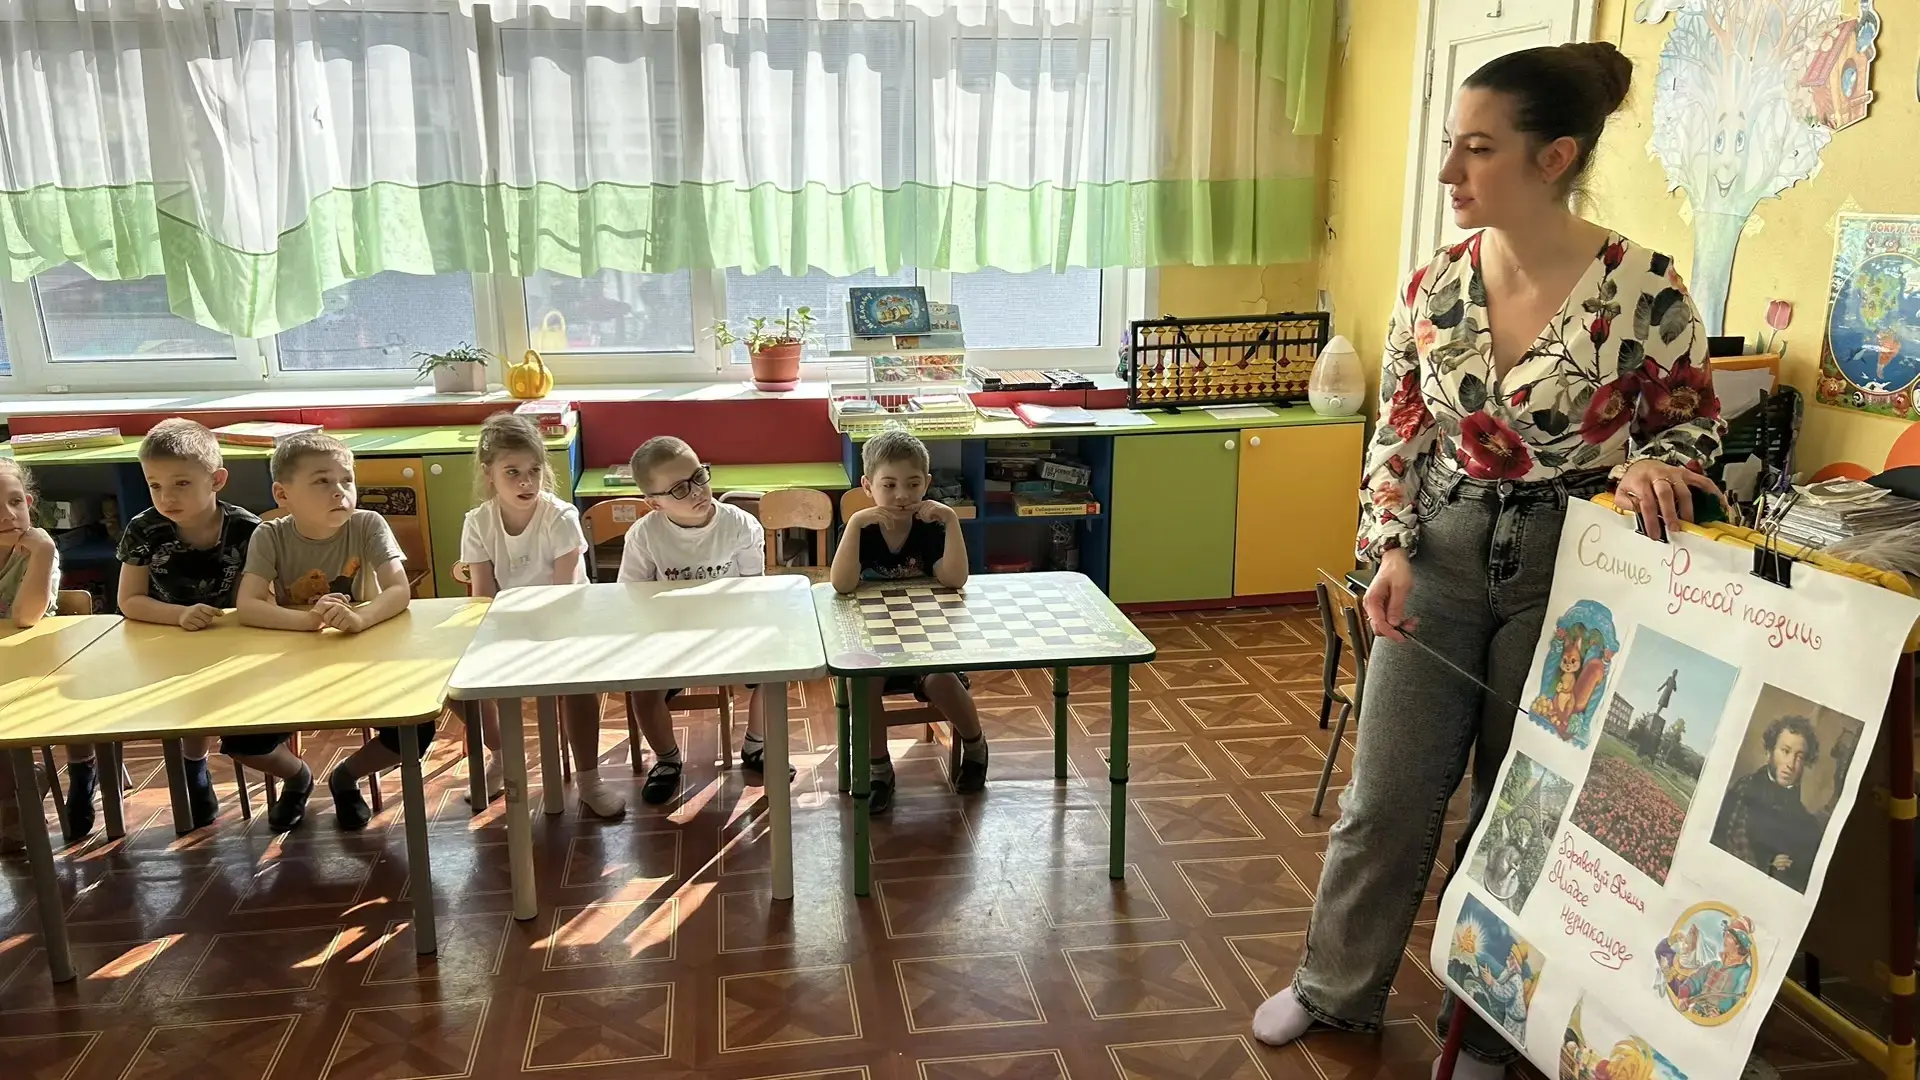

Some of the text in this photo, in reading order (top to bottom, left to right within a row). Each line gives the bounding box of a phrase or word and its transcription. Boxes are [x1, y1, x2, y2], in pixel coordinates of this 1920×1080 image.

[1577, 523, 1651, 585] Солнце
[1661, 544, 1822, 650] Русской поэзии
